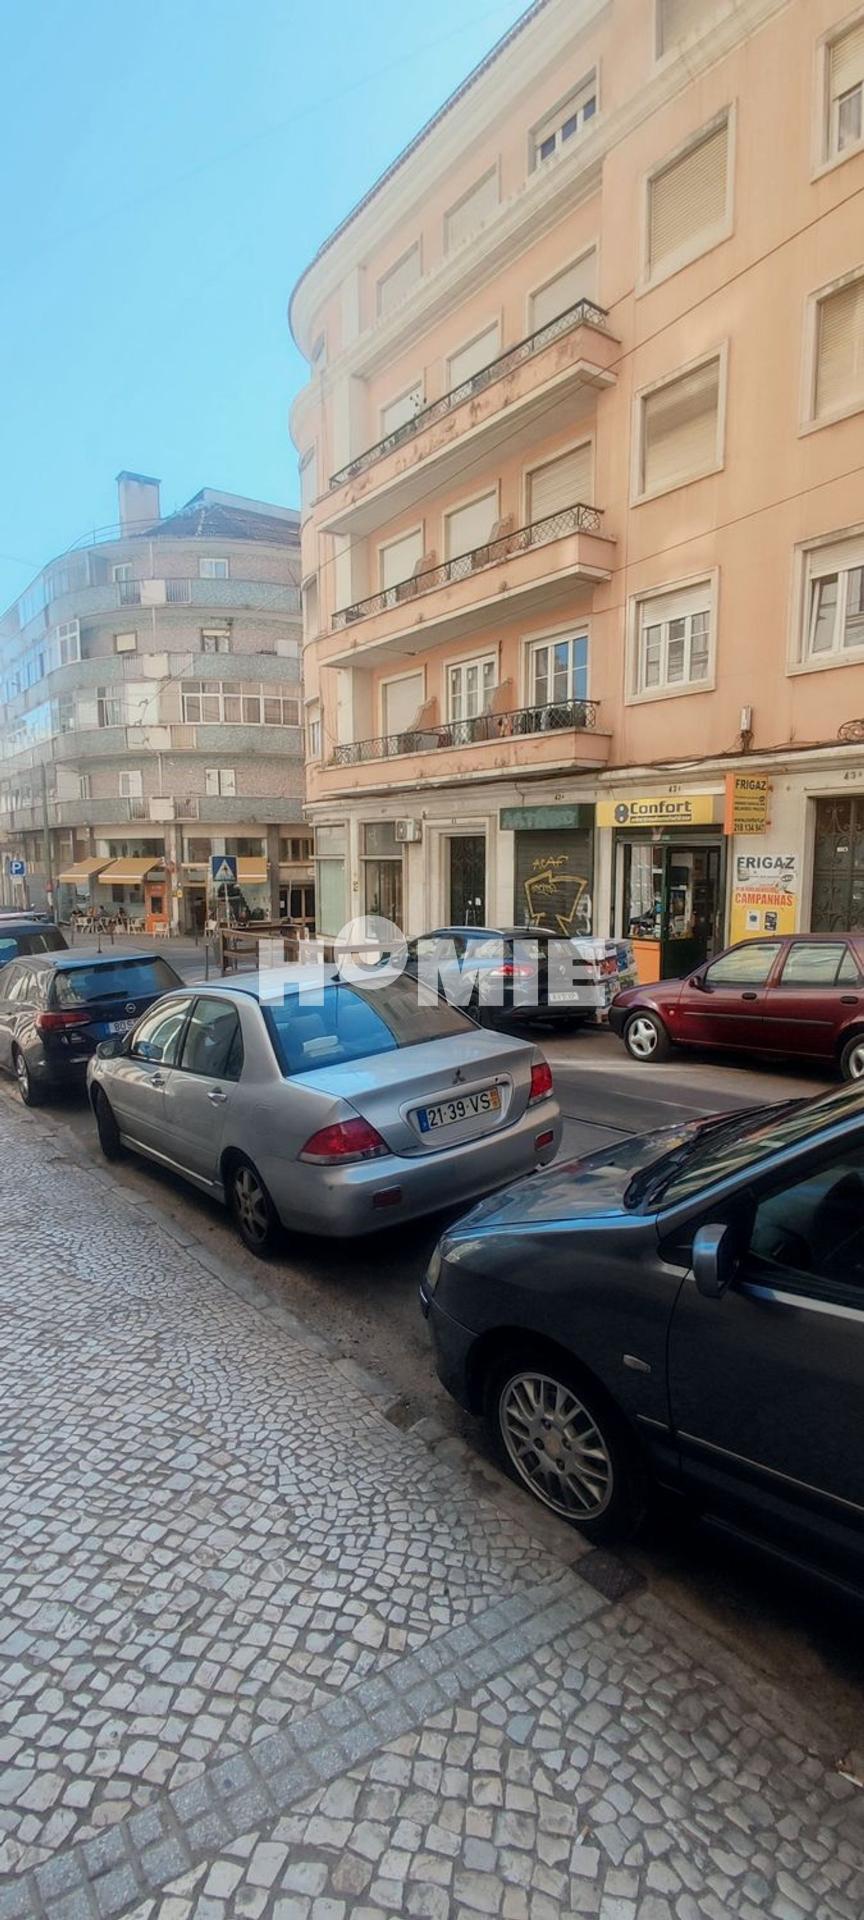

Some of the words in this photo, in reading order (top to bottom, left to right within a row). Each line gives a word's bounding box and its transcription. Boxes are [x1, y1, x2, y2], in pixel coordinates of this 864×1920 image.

[735, 779, 767, 791] FRIGAZ
[630, 800, 692, 815] Confort
[12, 862, 22, 874] P
[737, 856, 795, 870] FRIGAZ
[735, 892, 793, 907] CAMPANHAS
